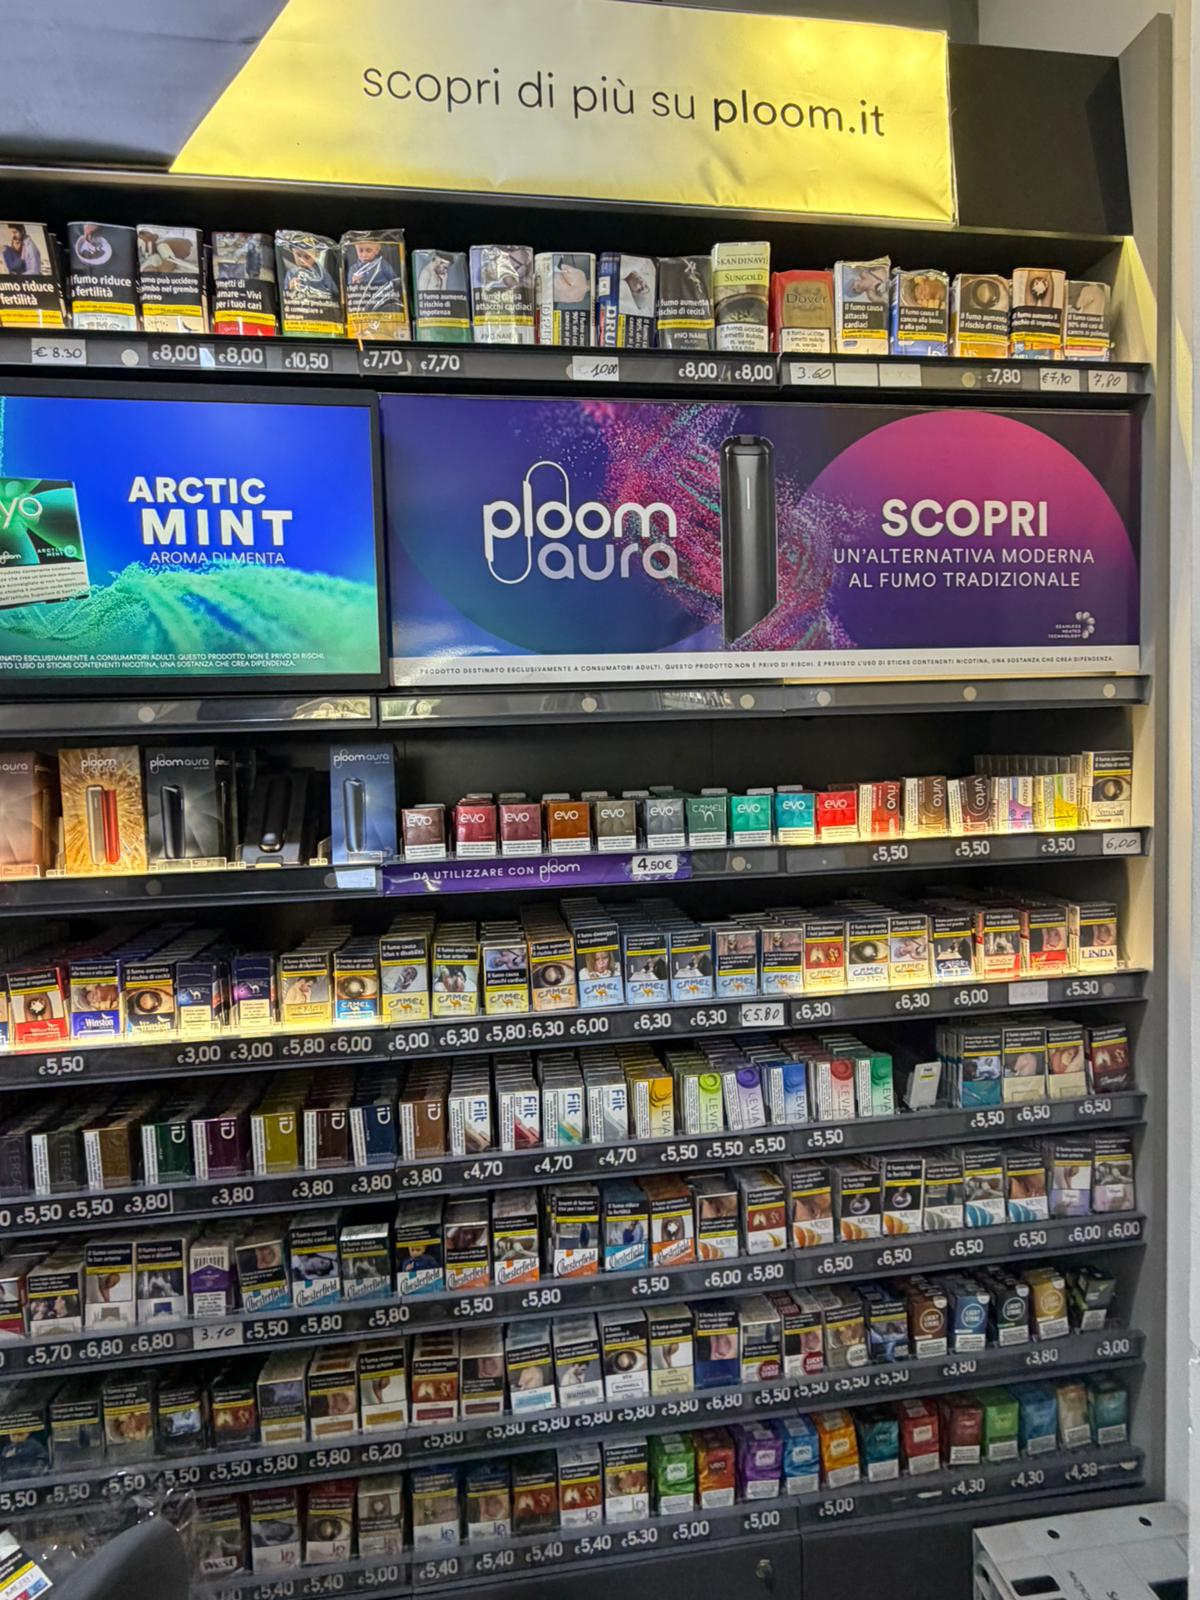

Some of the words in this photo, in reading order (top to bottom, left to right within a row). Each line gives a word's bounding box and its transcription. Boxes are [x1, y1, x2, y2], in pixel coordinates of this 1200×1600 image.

[362, 67, 501, 112] scopri
[518, 71, 555, 110] di
[572, 78, 634, 118] più
[651, 91, 695, 121] su
[713, 89, 885, 137] ploom.it
[73, 274, 98, 285] fumo
[100, 276, 132, 287] riduce
[724, 272, 764, 282] SUNGOLD
[75, 286, 113, 298] fertilità
[232, 300, 246, 310] tuoi
[247, 300, 262, 311] cari
[850, 304, 867, 312] fumo
[152, 345, 197, 363] €8,00
[218, 347, 263, 364] €8,00
[285, 352, 329, 371] €10,50
[363, 350, 403, 370] €7,70
[420, 354, 460, 373] €7,70
[678, 362, 717, 381] €8,00
[735, 363, 773, 383] €8,00
[986, 368, 1021, 385] €7,80
[128, 476, 266, 504] ARCTIC
[483, 460, 678, 585] ploom
[881, 498, 1048, 537] SCOPRI
[141, 508, 293, 547] MINT
[149, 551, 207, 564] AROMA
[212, 552, 229, 564] DI
[231, 552, 285, 565] MENTA
[537, 542, 679, 580] aura
[1002, 548, 1095, 564] MODERNA
[848, 573, 873, 588] AL
[880, 572, 937, 588] FUMO
[943, 571, 1080, 587] TRADIZIONALE
[2, 763, 29, 771] aura
[80, 753, 117, 773] ploom
[150, 753, 184, 775] ploom
[184, 758, 209, 767] aura
[333, 750, 365, 770] ploom
[366, 753, 390, 761] aura
[932, 779, 942, 807] virto
[974, 777, 985, 807] virto
[650, 805, 674, 817] evo
[736, 803, 760, 813] evo
[782, 800, 806, 810] evo
[824, 798, 848, 809] evo
[460, 812, 485, 824] evo
[504, 812, 530, 823] evo
[554, 810, 579, 821] evo
[600, 808, 625, 819] evo
[872, 845, 908, 863] €5,50
[955, 840, 990, 857] €5,50
[1041, 837, 1075, 854] €3,50
[413, 871, 429, 881] DA
[433, 867, 504, 879] UTILIZZARE
[508, 866, 534, 876] CON
[539, 858, 581, 883] ploom
[1081, 948, 1114, 959] LINDA
[895, 993, 930, 1010] €6,30
[954, 989, 989, 1006] €6,00
[796, 1002, 831, 1020] €6,30
[85, 1018, 114, 1029] Winston
[569, 1017, 609, 1036] €6,00
[633, 1013, 671, 1031] €6,30
[388, 1032, 430, 1051] €6,00
[485, 1024, 526, 1043] €5,80
[282, 1038, 325, 1055] €5,80
[330, 1036, 372, 1053] €6,00
[177, 1045, 221, 1065] €3,00
[38, 1056, 84, 1077] €5,50
[882, 1080, 892, 1114] LEVIA
[708, 1097, 719, 1132] LEVIA
[747, 1092, 759, 1125] LEVIA
[661, 1103, 671, 1135] LEVIA
[660, 1144, 698, 1163] €5,50
[749, 1136, 785, 1155] €5,50
[534, 1154, 573, 1174] €4,70
[599, 1147, 637, 1167] €4,70
[463, 1161, 503, 1180] €4,70
[292, 1179, 333, 1198] €3,80
[351, 1174, 392, 1193] €3,80
[212, 1186, 254, 1206] €3,80
[1013, 1231, 1047, 1248] €6,50
[1068, 1225, 1101, 1242] €6,00
[877, 1248, 912, 1266] €6,50
[949, 1239, 984, 1257] €6,50
[556, 1250, 596, 1273] Chesterfield
[817, 1257, 853, 1274] €6,50
[498, 1258, 538, 1285] Chesterfield
[746, 1264, 784, 1283] €5,80
[400, 1269, 440, 1295] Chesterfield
[631, 1277, 670, 1295] €5,50
[295, 1280, 337, 1307] Chesterfield
[300, 1314, 342, 1334] €5,80
[368, 1306, 410, 1327] €5,80
[246, 1320, 288, 1340] €5,50
[1097, 1339, 1130, 1357] €3,00
[1025, 1349, 1059, 1367] €3,80
[755, 1386, 791, 1406] €5,50
[309, 1448, 351, 1468] €5,80
[361, 1443, 402, 1463] €6,20
[209, 1460, 251, 1480] €5,50
[255, 1454, 298, 1474] €5,80
[951, 1478, 986, 1495] €4,30
[1010, 1470, 1045, 1488] €4,30
[819, 1498, 854, 1517] €5,00
[743, 1510, 780, 1530] €5,00
[673, 1521, 710, 1541] €5,00
[525, 1542, 564, 1563] €5,40
[575, 1534, 612, 1555] €5,40
[476, 1550, 514, 1571] €5,40
